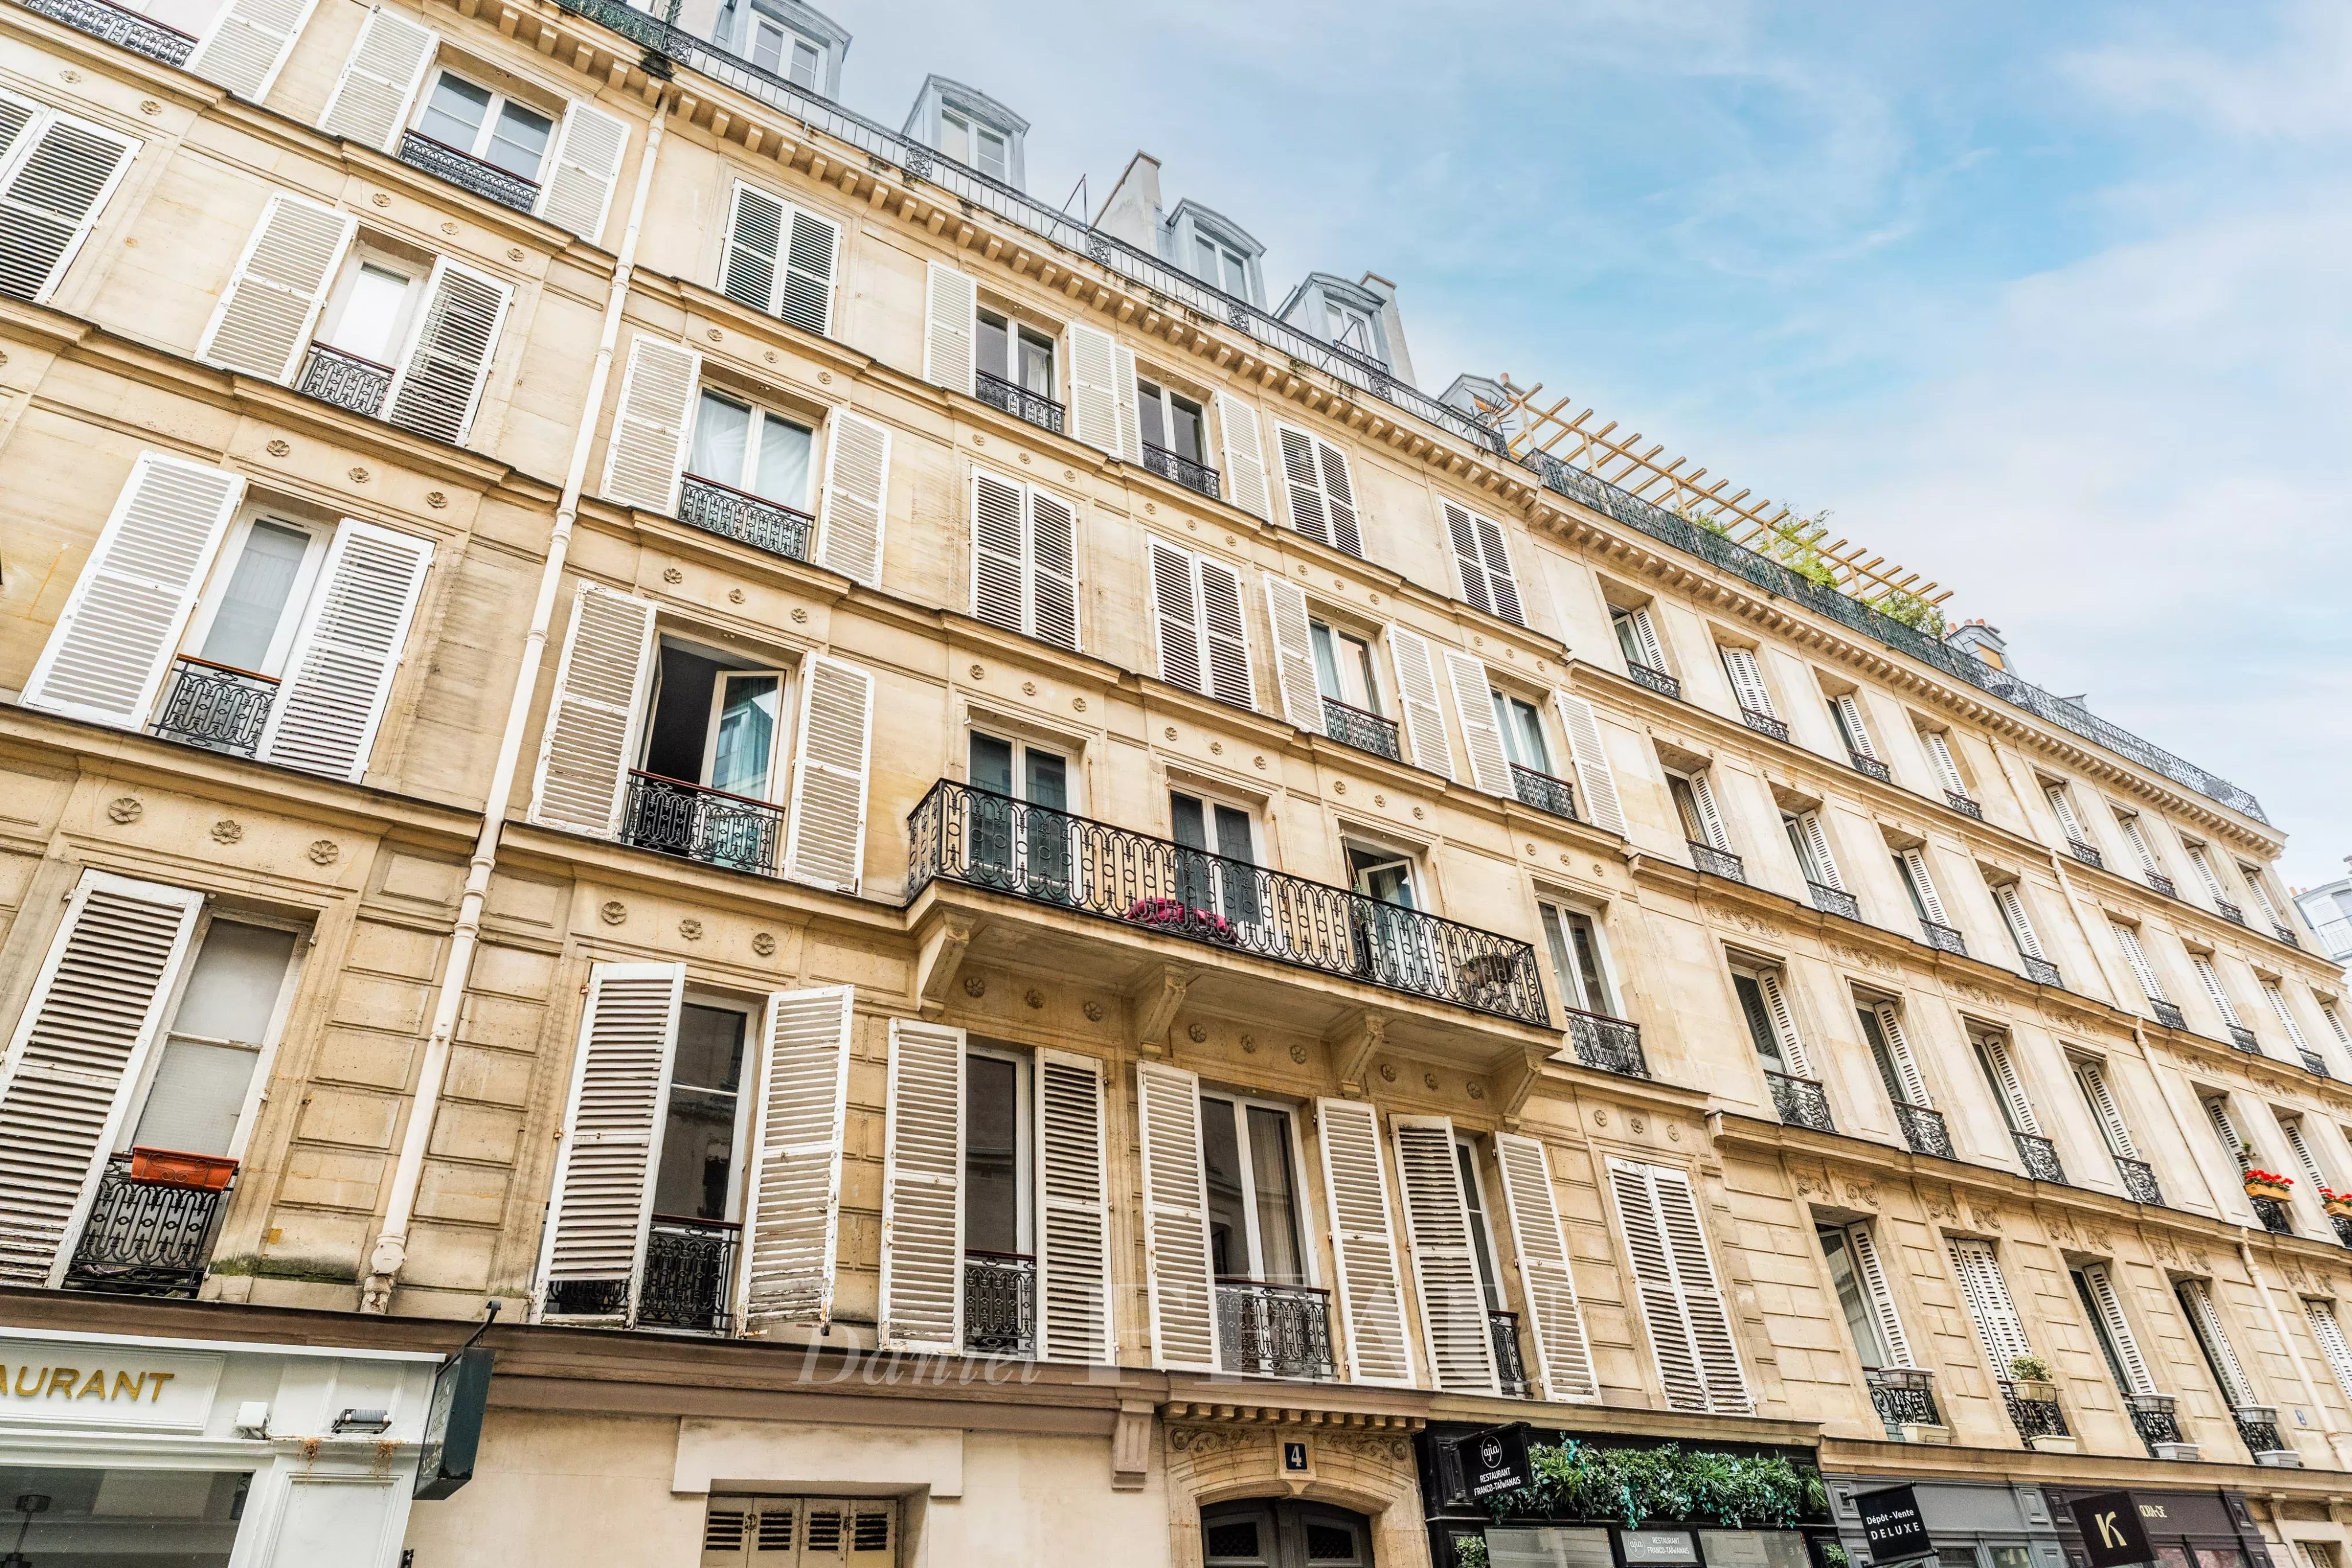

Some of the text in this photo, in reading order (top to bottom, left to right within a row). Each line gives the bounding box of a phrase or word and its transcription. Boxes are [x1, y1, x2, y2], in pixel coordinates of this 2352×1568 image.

[1291, 1445, 1302, 1467] 4
[1483, 1443, 1500, 1462] ajia
[1479, 1467, 1511, 1484] RESTAURANT
[1870, 1521, 1920, 1540] DELUXE
[2094, 1511, 2127, 1548] K
[1630, 1538, 1643, 1552] ajia
[1651, 1536, 1680, 1544] RESTAURANT
